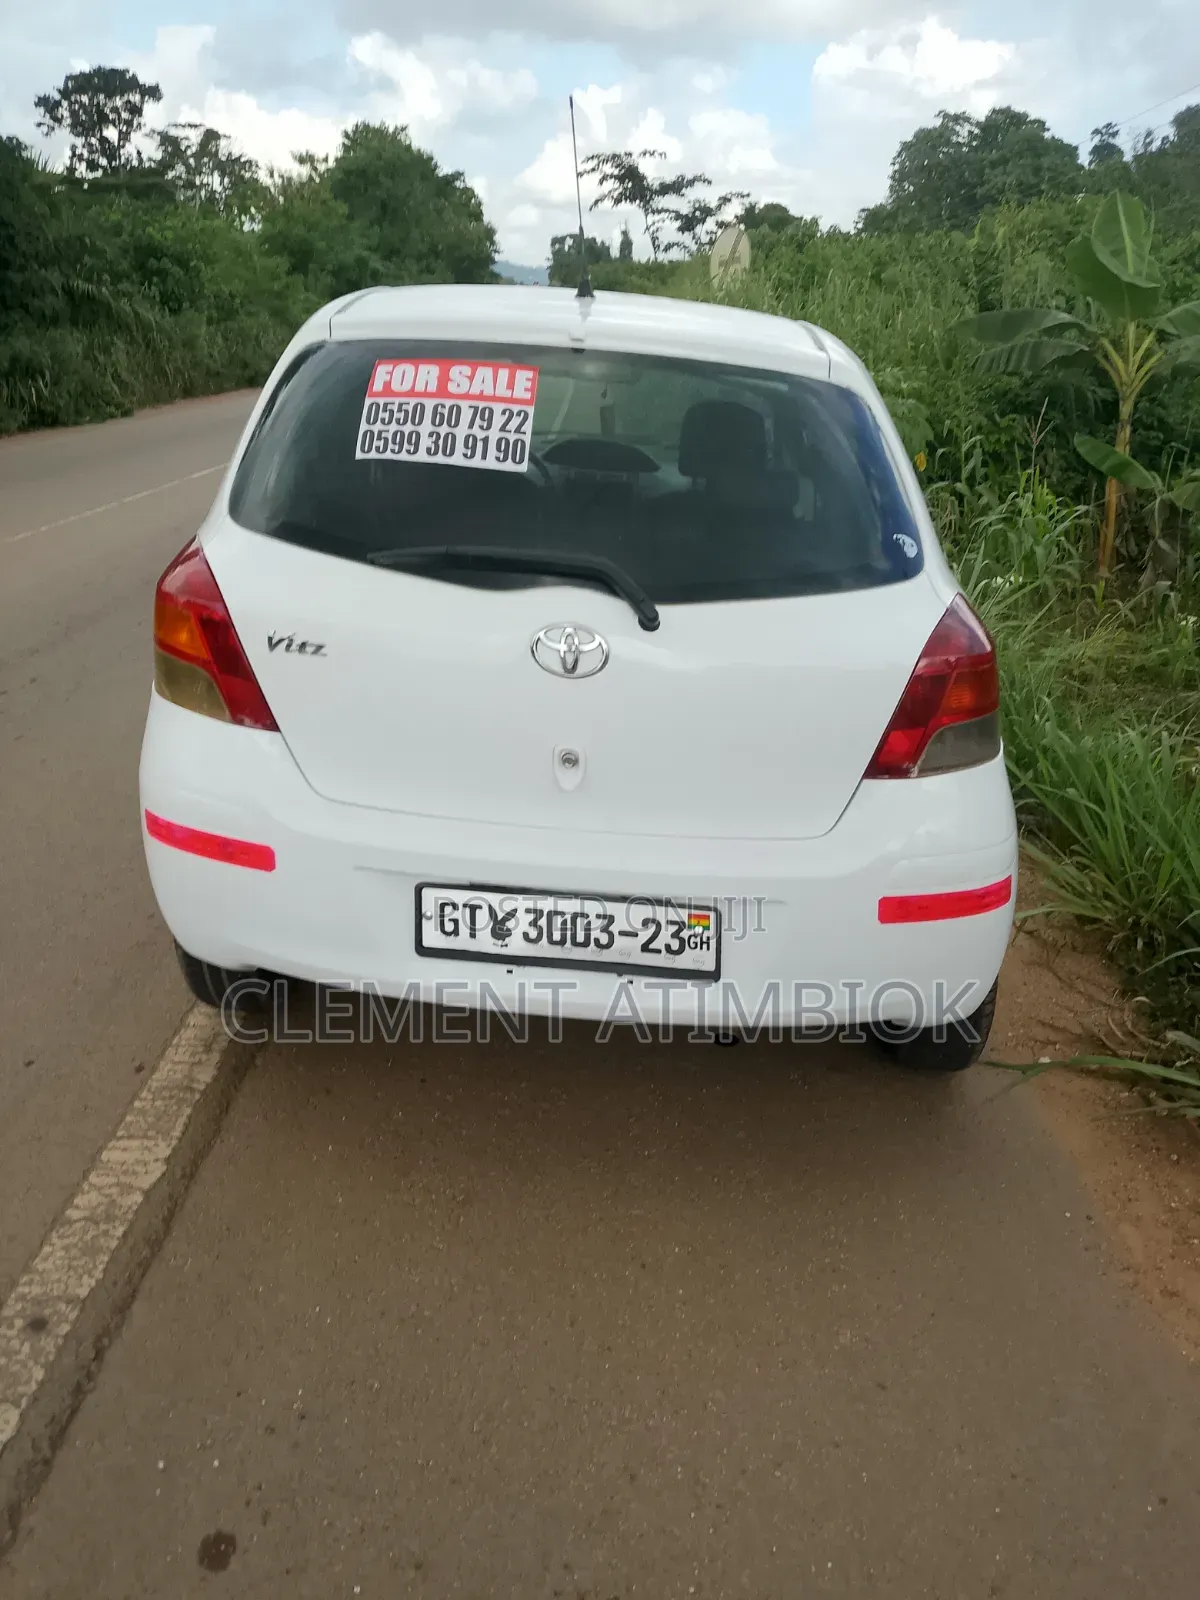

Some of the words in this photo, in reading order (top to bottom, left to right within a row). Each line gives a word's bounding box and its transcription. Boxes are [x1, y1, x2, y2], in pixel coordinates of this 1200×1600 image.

[372, 363, 440, 393] FOR
[447, 364, 534, 400] SALE
[365, 401, 426, 426] 0550
[430, 402, 462, 428] 60
[467, 405, 494, 431] 79
[499, 407, 529, 435] 22
[360, 429, 421, 455] 0599
[426, 431, 457, 457] 30
[462, 433, 490, 461] 91
[495, 436, 527, 465] 90
[522, 907, 687, 956] 3003-23
[687, 935, 711, 952] GH
